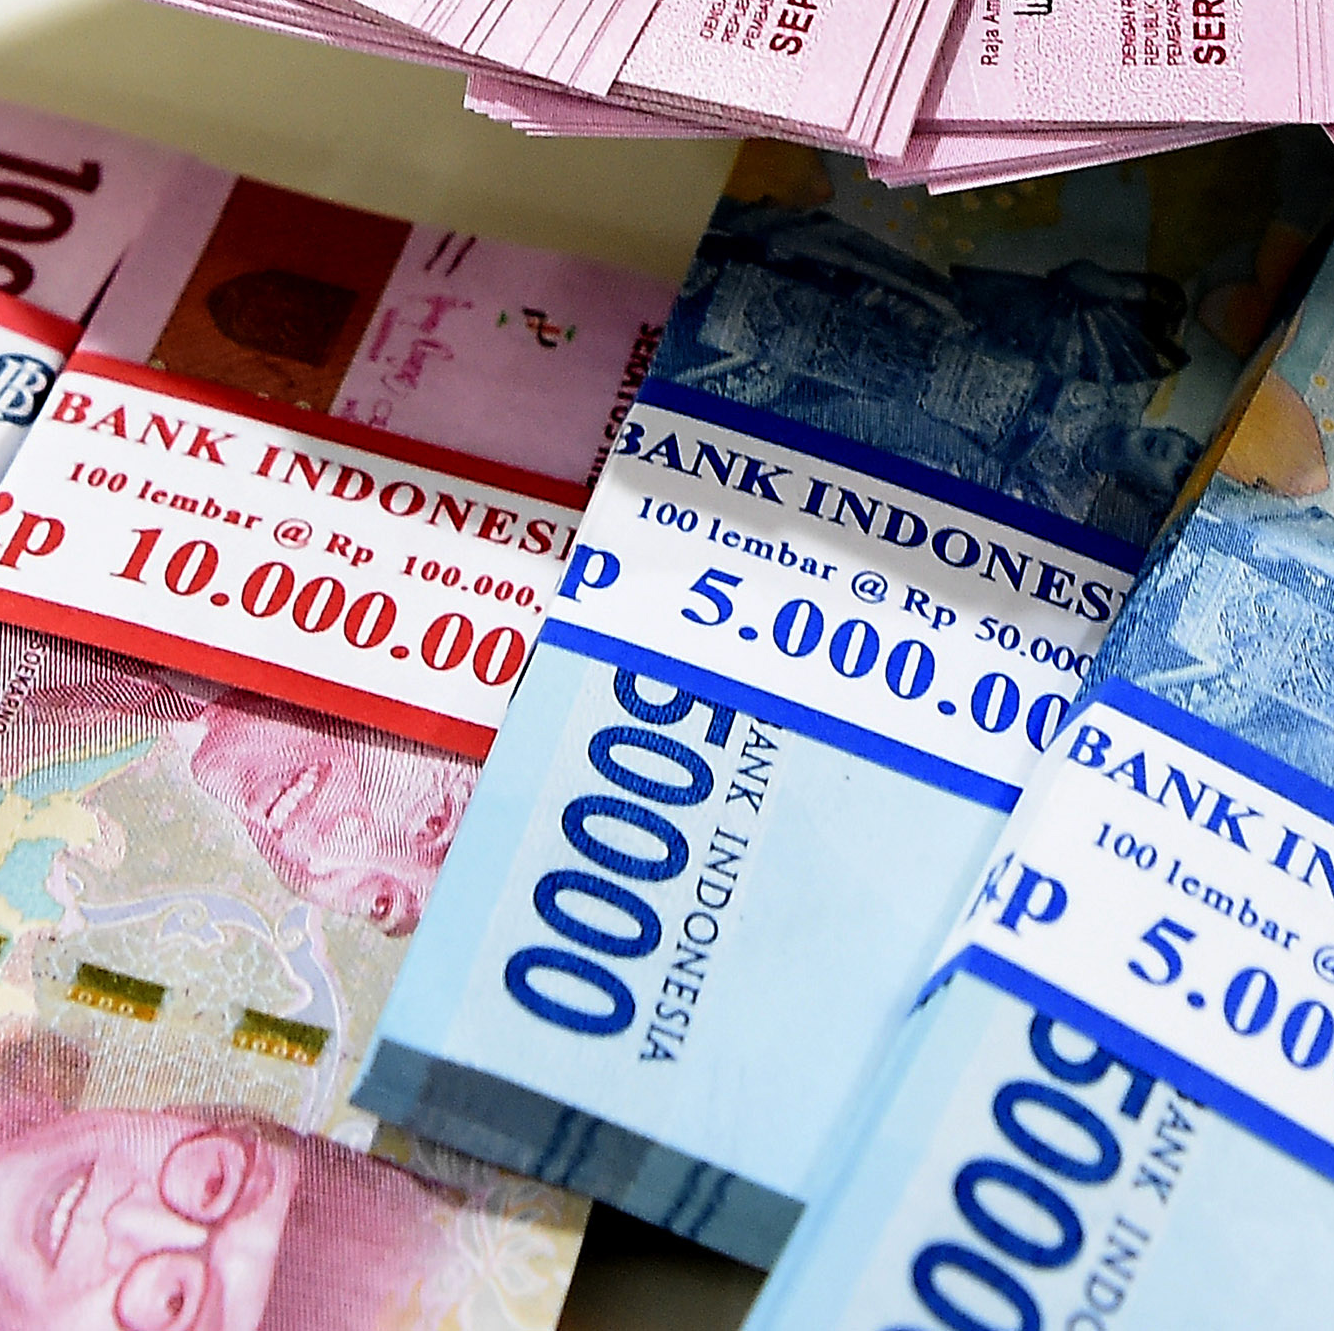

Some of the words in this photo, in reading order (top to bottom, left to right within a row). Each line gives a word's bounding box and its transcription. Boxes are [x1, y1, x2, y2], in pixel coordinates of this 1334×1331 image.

[979, 28, 1004, 66] Raja
[50, 390, 235, 466] BANK
[69, 462, 128, 493] 100
[137, 479, 263, 529] lembar
[272, 519, 313, 547] @
[324, 531, 374, 567] Rp
[637, 496, 699, 533] 100
[707, 517, 838, 581] lembar
[850, 569, 888, 604] @
[901, 584, 957, 630] Rp
[797, 479, 1130, 624] INDONES
[503, 667, 734, 1038] 50000
[1066, 724, 1263, 852] BANK
[638, 825, 749, 1061] INDONESIA
[972, 854, 1068, 933] p
[1095, 822, 1158, 870] 100
[1166, 859, 1300, 949] lembar
[880, 1009, 1151, 1331] 5000
[1134, 1080, 1206, 1210] ANK
